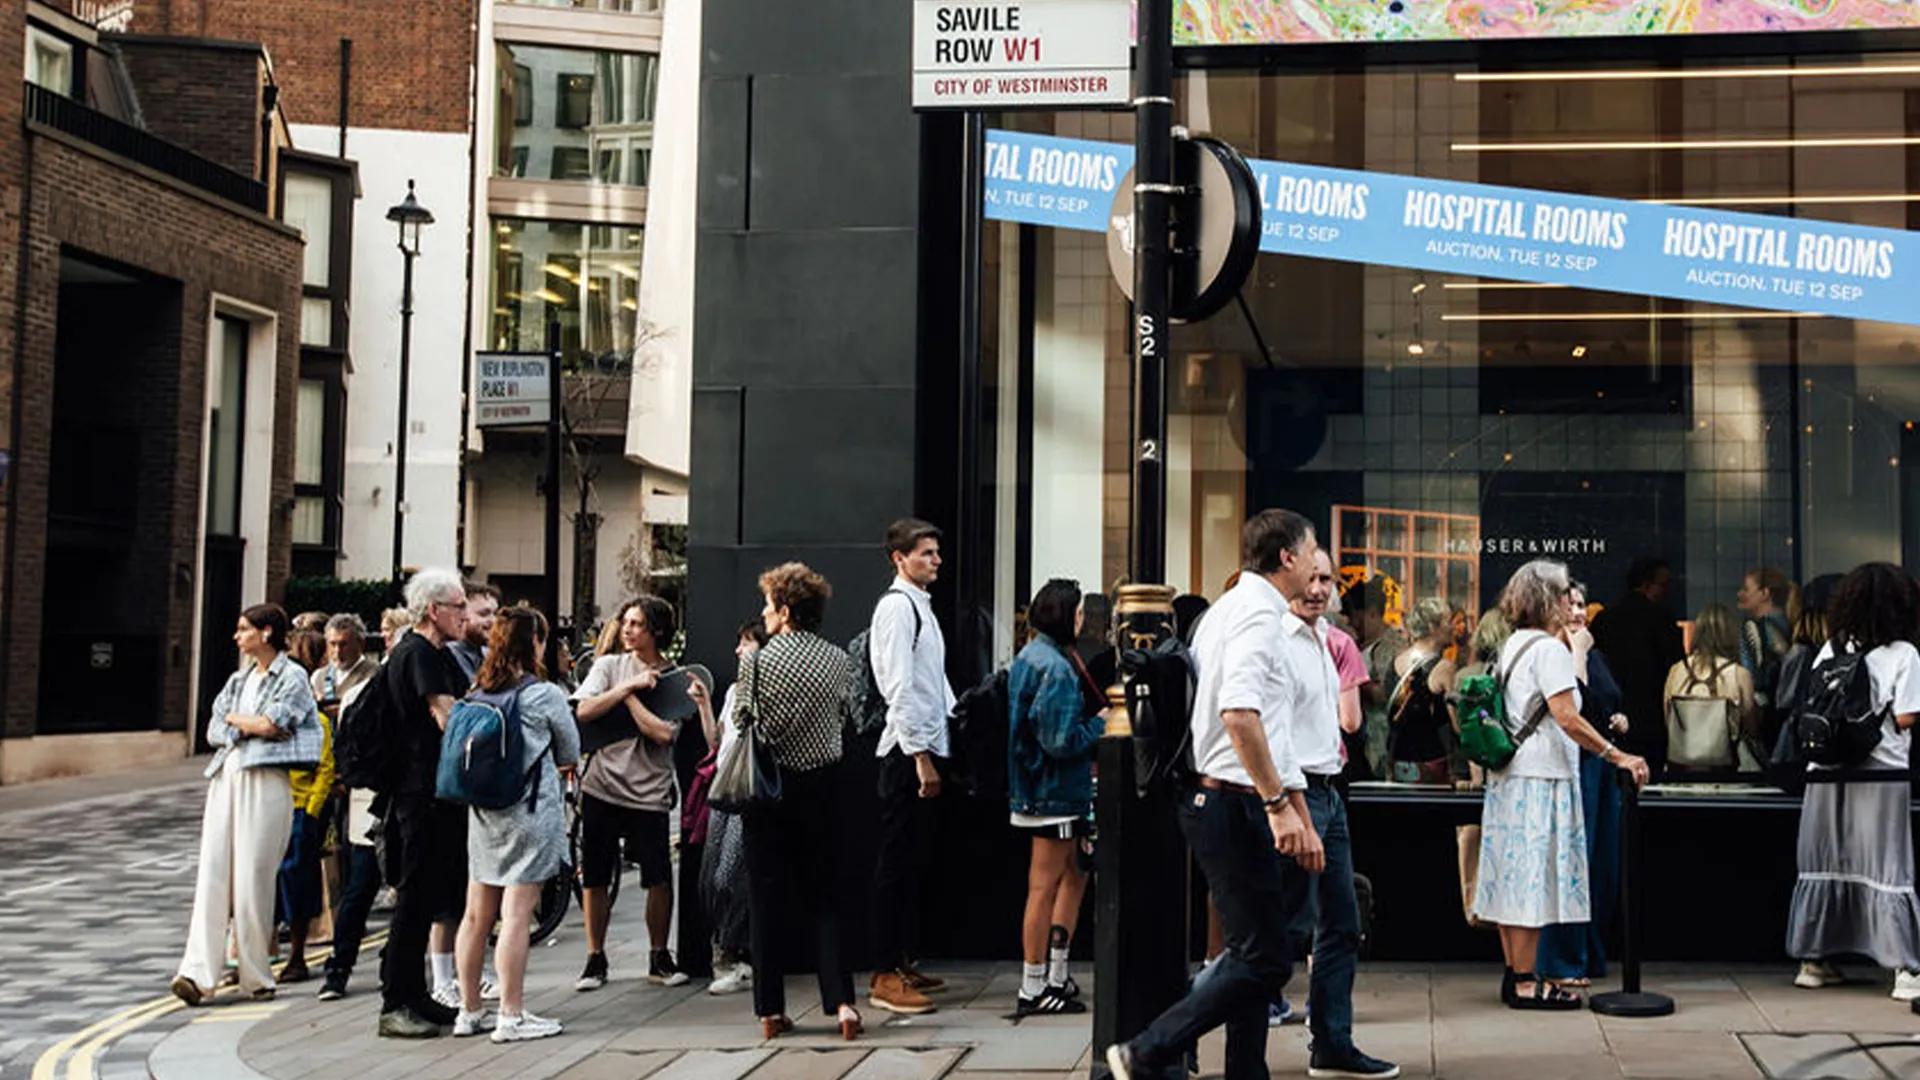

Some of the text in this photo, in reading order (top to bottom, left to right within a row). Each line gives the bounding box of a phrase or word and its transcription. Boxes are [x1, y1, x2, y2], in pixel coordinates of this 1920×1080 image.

[937, 7, 1020, 32] SAVILE
[936, 37, 1041, 63] ROW W1
[934, 77, 1108, 96] CITY OF WESTMINSTER
[1027, 147, 1119, 192] ROOMS
[1005, 190, 1035, 208] TUE
[1039, 195, 1053, 209] 12
[1058, 197, 1089, 212] SEP
[1276, 176, 1370, 220] ROOMS
[1263, 220, 1340, 242] UE 12 SEP
[1403, 190, 1628, 250] HOSPITAL ROOMS
[1509, 248, 1540, 266] TUE
[1544, 252, 1560, 267] 12
[1564, 254, 1597, 272] SEP
[1663, 218, 1895, 279] HOSPITAL ROOMS
[1771, 277, 1805, 296] TUE
[1810, 282, 1825, 297] 12
[1829, 283, 1863, 300] SEP
[481, 381, 505, 397] PLACE
[1142, 439, 1156, 460] 2
